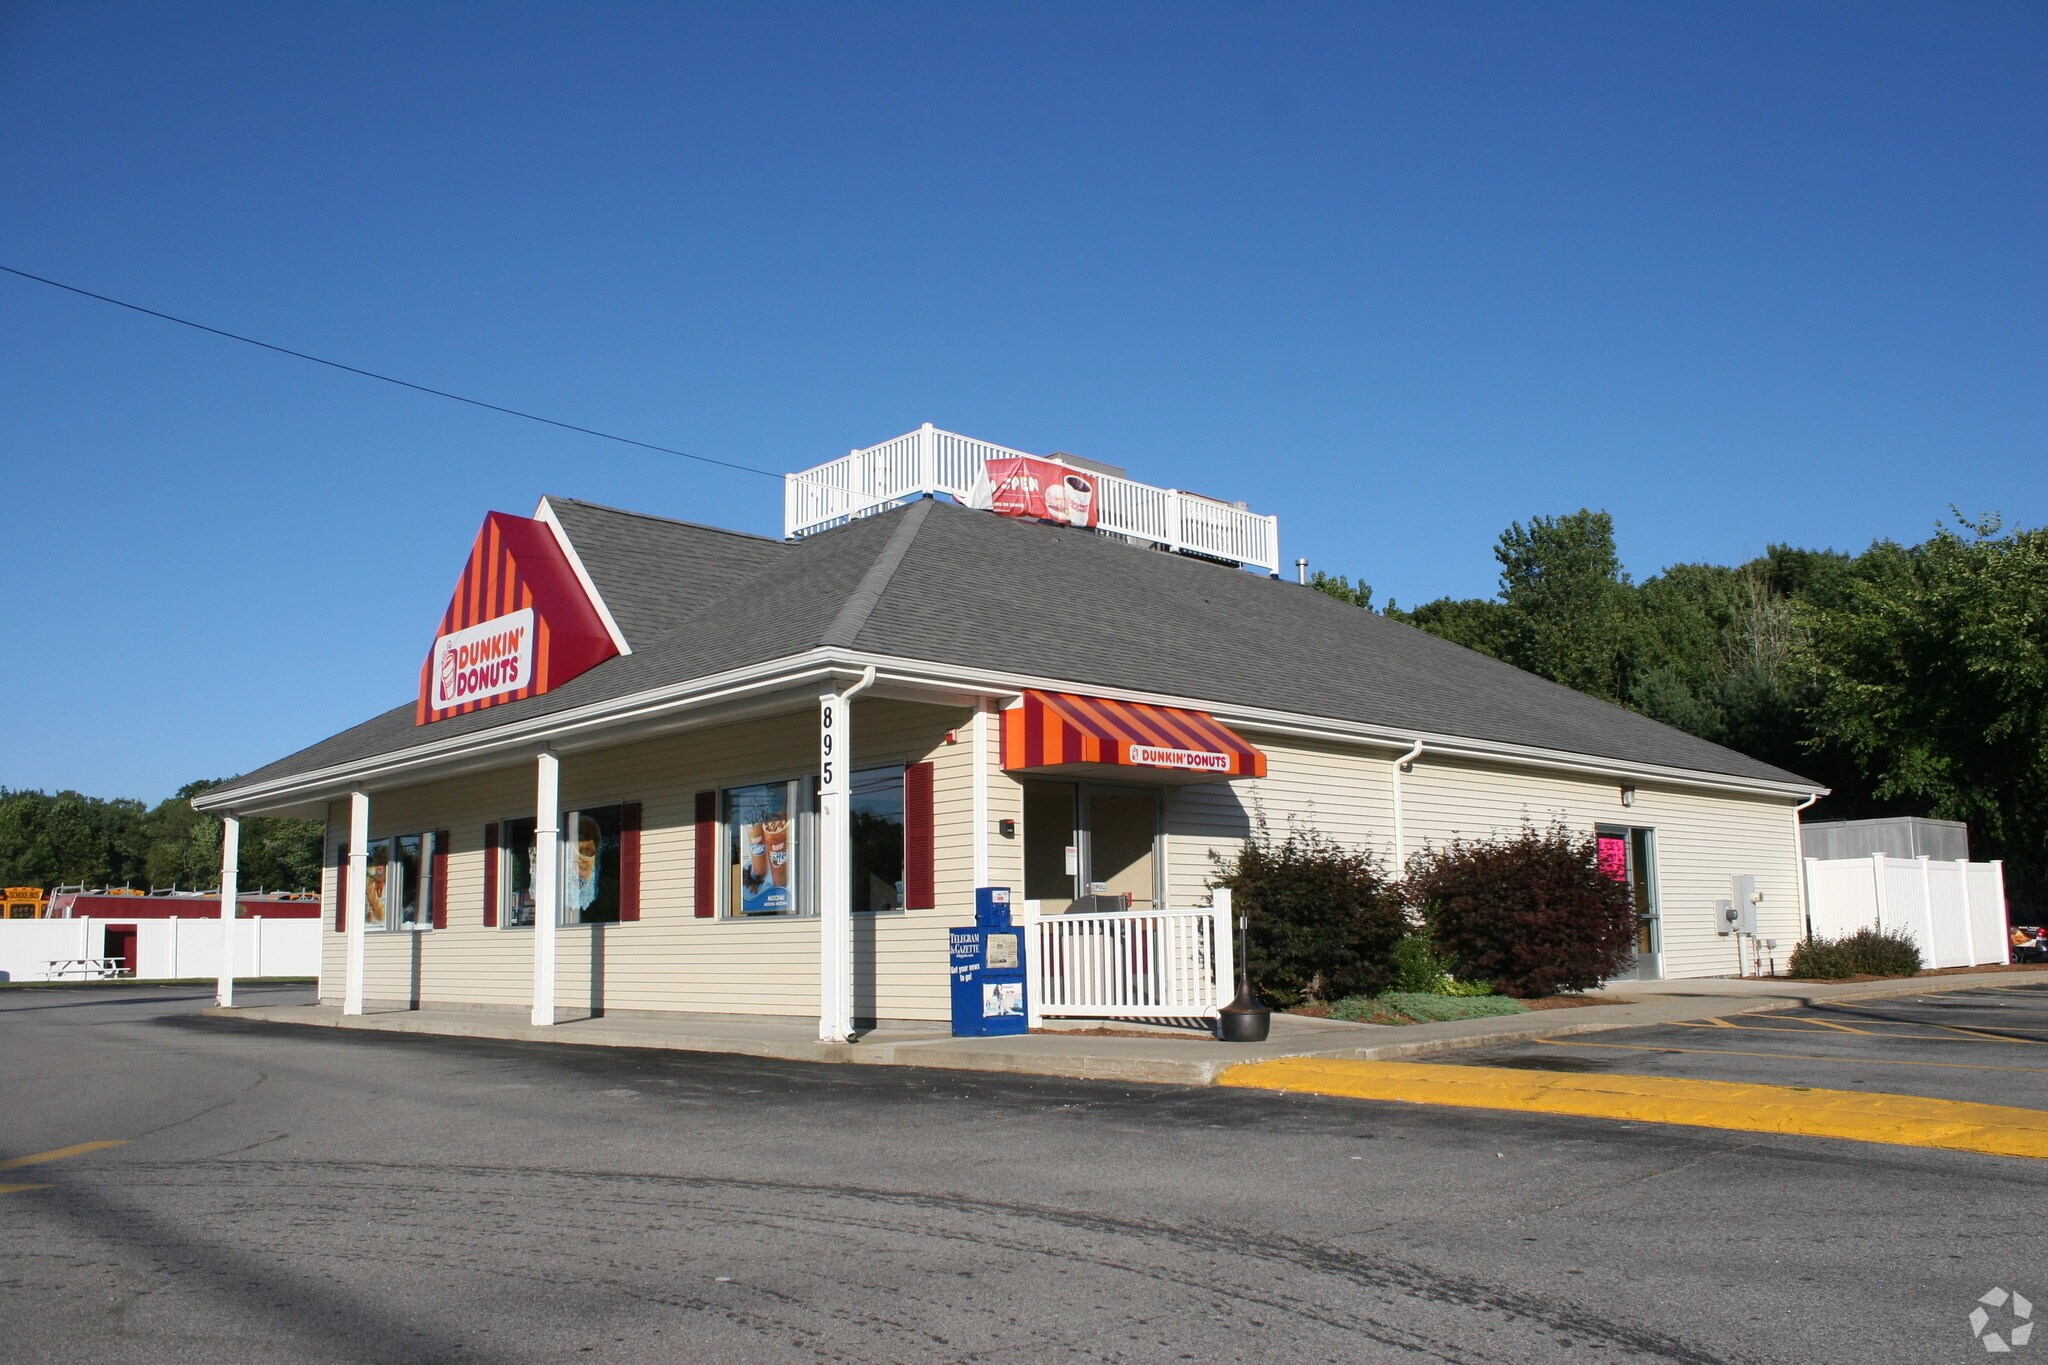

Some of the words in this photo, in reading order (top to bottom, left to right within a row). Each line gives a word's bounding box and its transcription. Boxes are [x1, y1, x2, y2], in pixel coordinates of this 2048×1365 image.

[459, 626, 525, 670] DUNKIN'
[457, 656, 519, 697] DONUTS
[823, 706, 833, 785] 895
[1142, 749, 1186, 764] DUNKIN'
[1187, 753, 1227, 768] DONUTS
[9, 891, 29, 899] SCHOOL
[29, 891, 40, 899] BUS
[950, 933, 980, 944] TELEGRAM
[955, 943, 980, 954] GAZETTE
[959, 965, 968, 974] your
[969, 963, 980, 972] news
[960, 974, 965, 982] to
